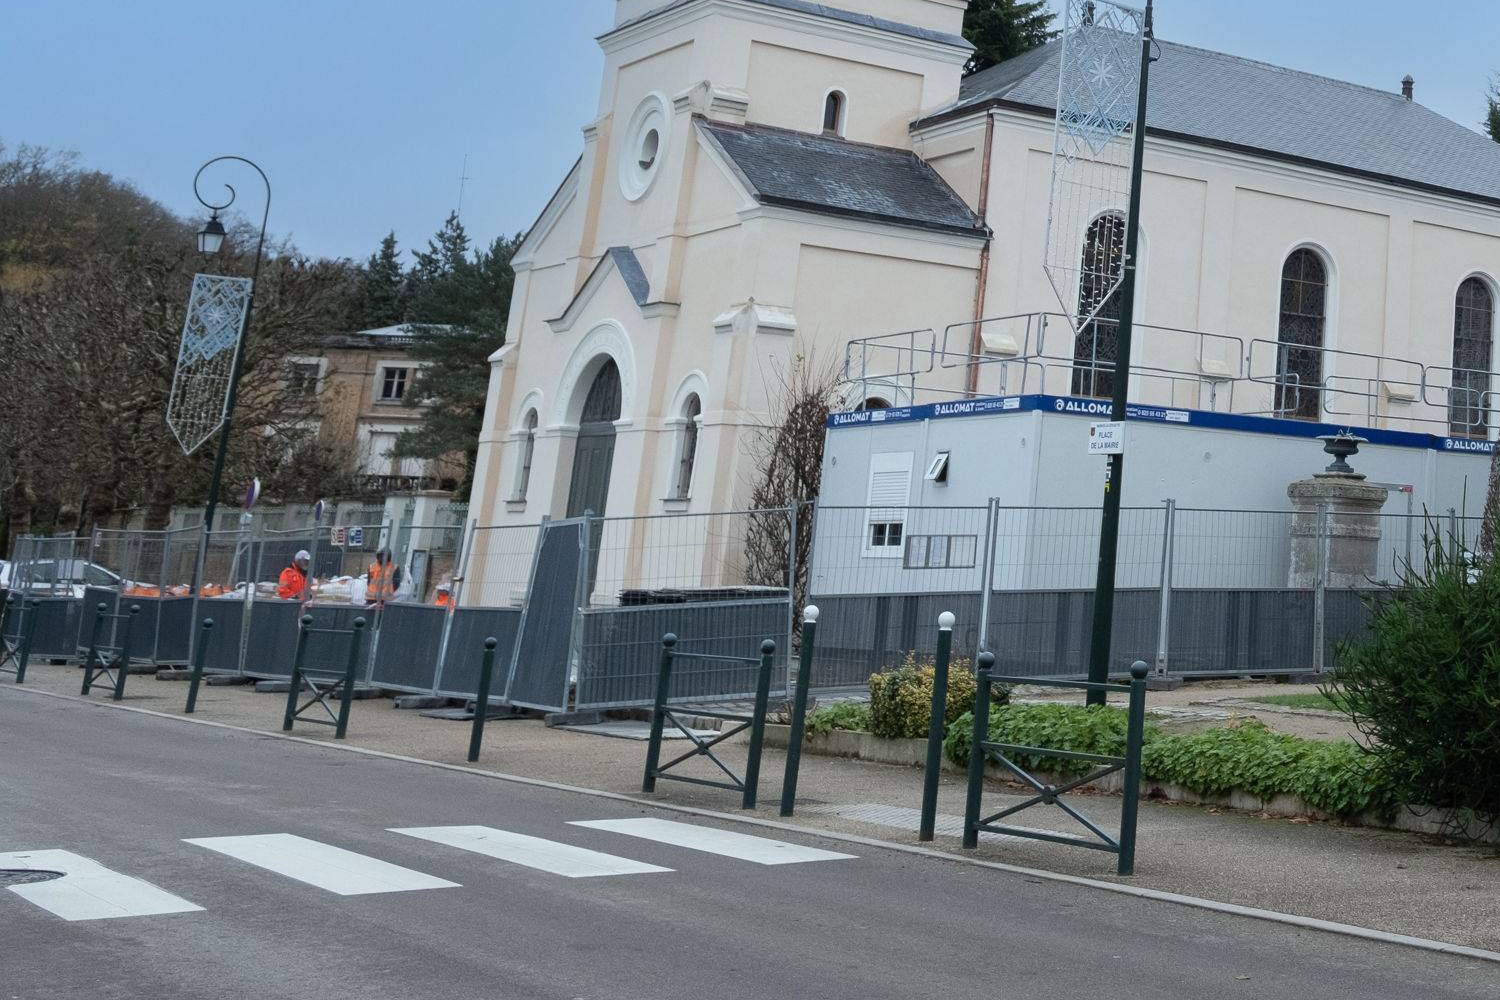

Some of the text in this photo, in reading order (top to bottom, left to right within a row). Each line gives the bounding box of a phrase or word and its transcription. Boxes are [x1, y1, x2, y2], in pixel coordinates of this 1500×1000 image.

[941, 402, 975, 414] ALLOMAT
[1065, 401, 1113, 415] ALLOMA
[839, 411, 870, 424] ALLOMAT
[1099, 431, 1113, 439] PLACE
[1104, 441, 1119, 449] MAIRIE
[1453, 442, 1495, 451] ALLOMAT
